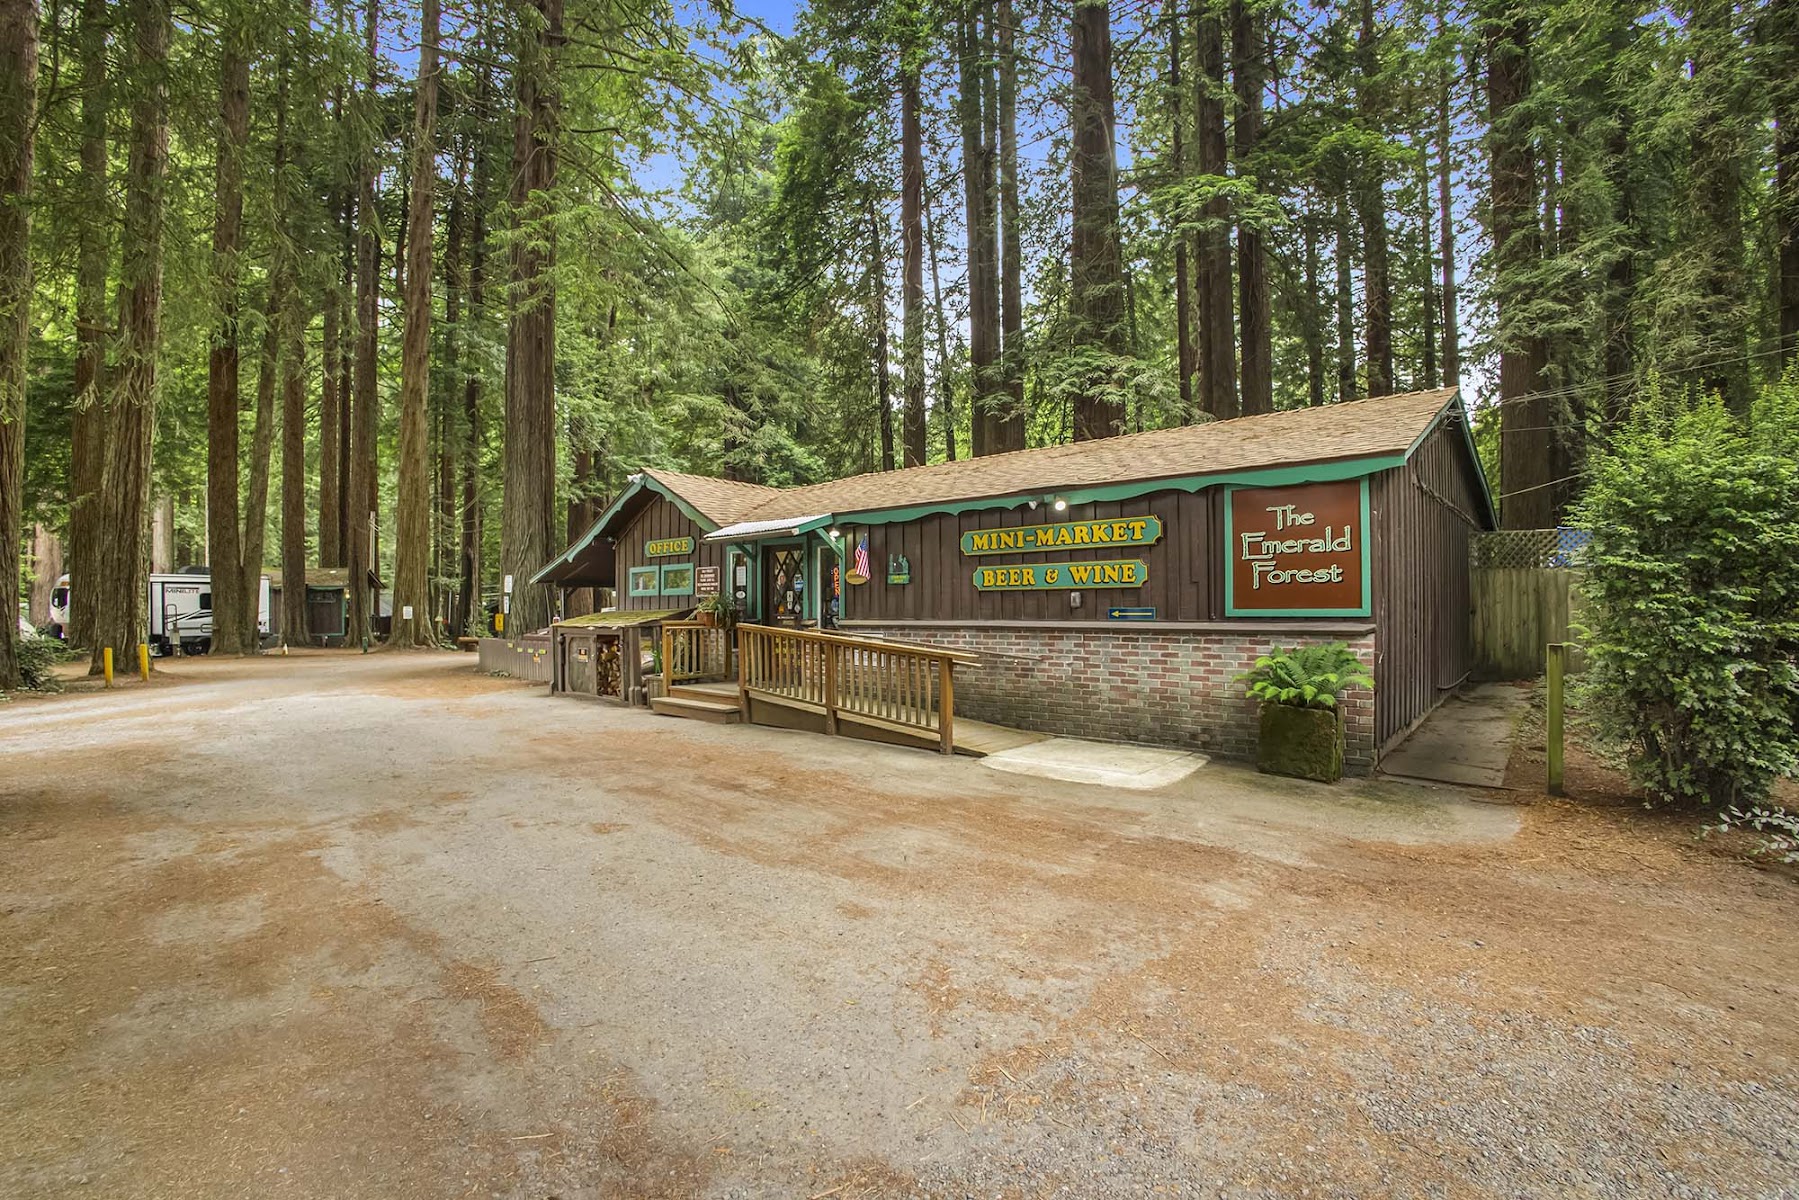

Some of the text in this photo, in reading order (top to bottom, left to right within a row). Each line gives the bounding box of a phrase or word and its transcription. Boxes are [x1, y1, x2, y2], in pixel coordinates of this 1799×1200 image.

[1266, 504, 1315, 530] The
[649, 540, 689, 554] OFFICE
[972, 521, 1146, 550] MINI-MARKET
[1241, 525, 1352, 559] Emerald
[983, 564, 1136, 587] BEER & WINE
[1252, 561, 1343, 589] Forest
